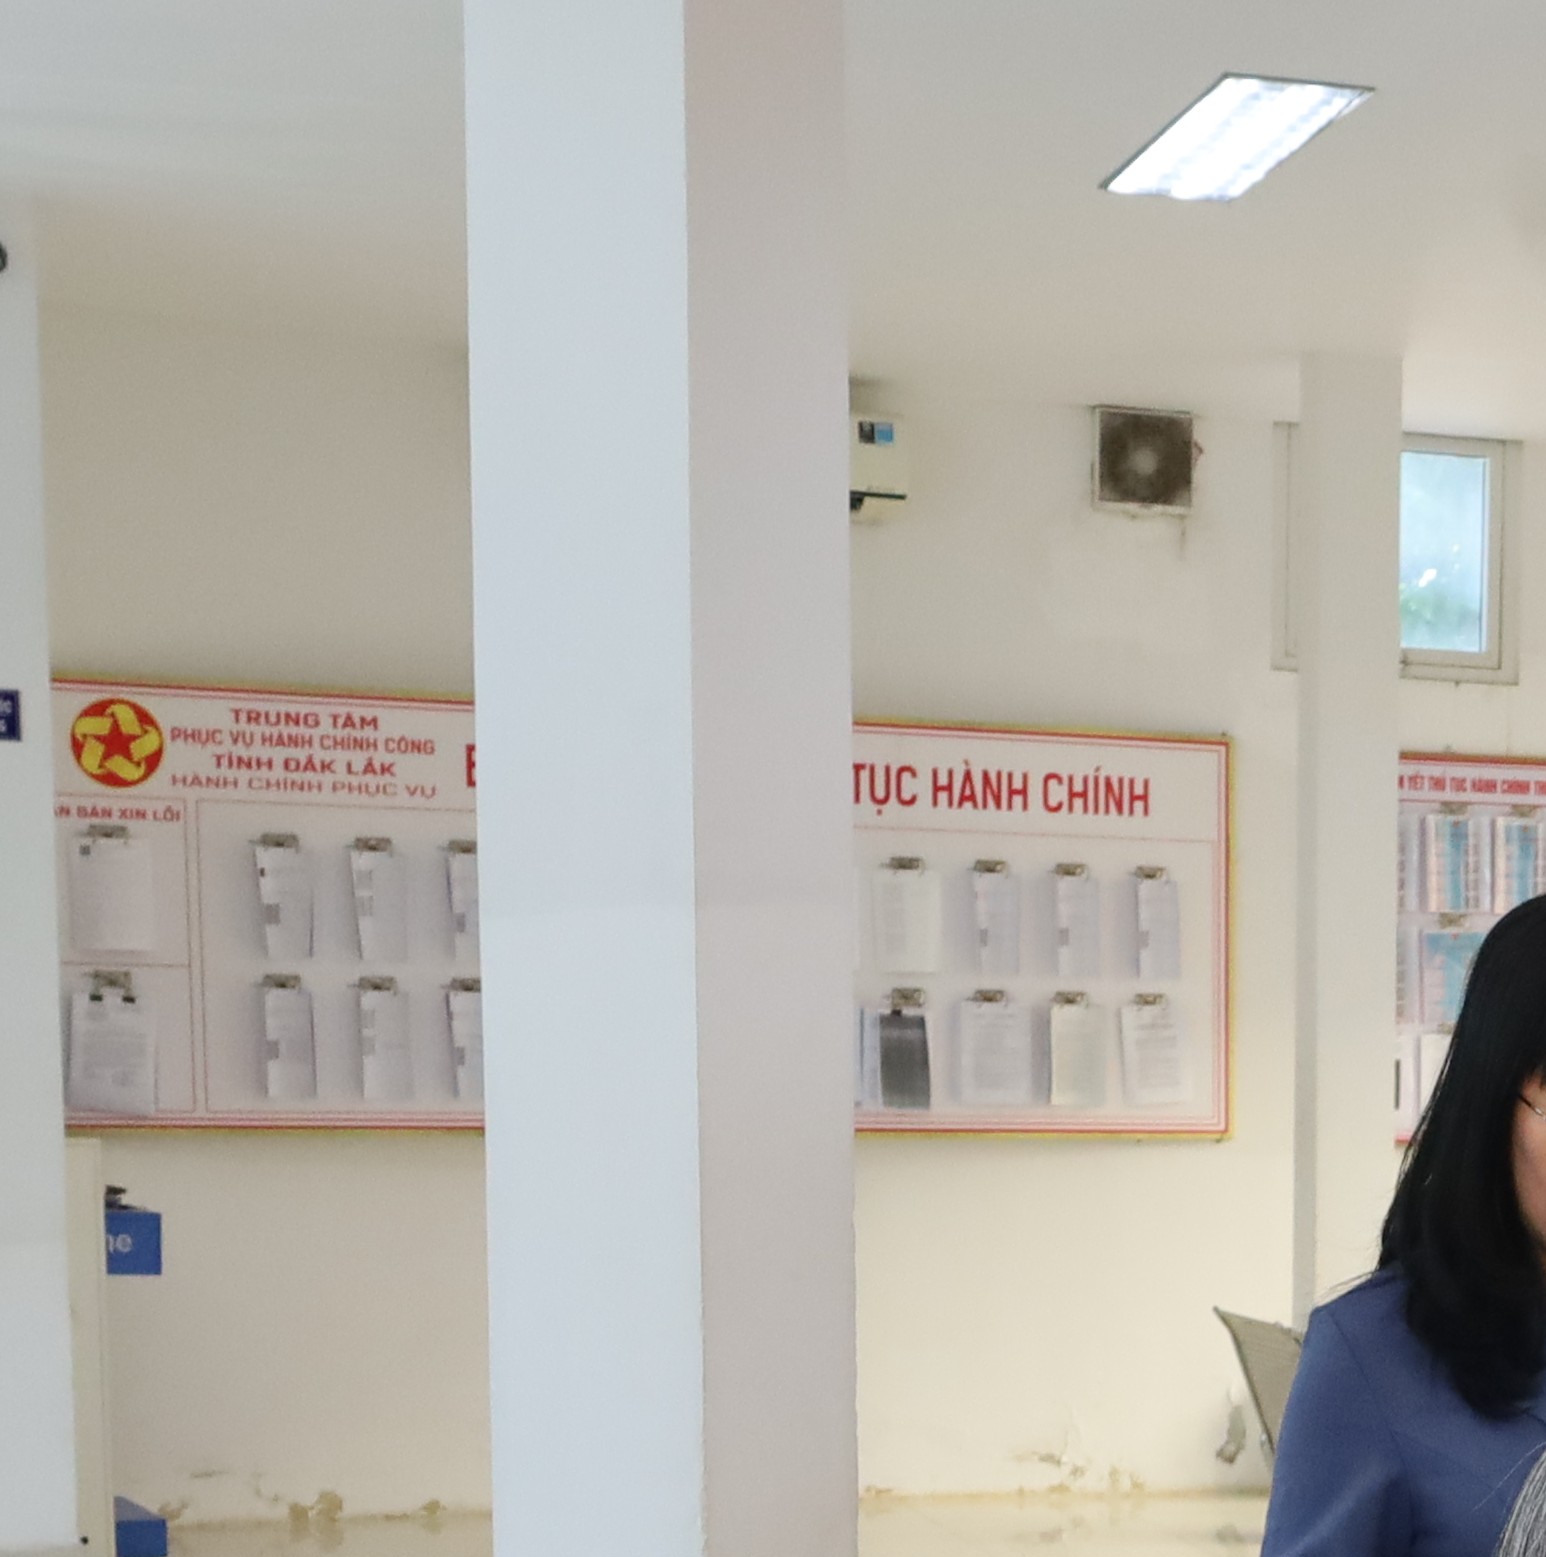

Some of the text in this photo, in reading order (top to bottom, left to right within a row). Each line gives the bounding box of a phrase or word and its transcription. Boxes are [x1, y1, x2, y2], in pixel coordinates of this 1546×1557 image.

[231, 708, 379, 730] TRUNG TÂM
[170, 727, 223, 748] PHỤC
[261, 729, 313, 750] HÀNH
[384, 735, 436, 756] CÔNG
[853, 758, 1150, 817] TỤC HÀNH CHÍNH
[118, 808, 147, 820] XIN
